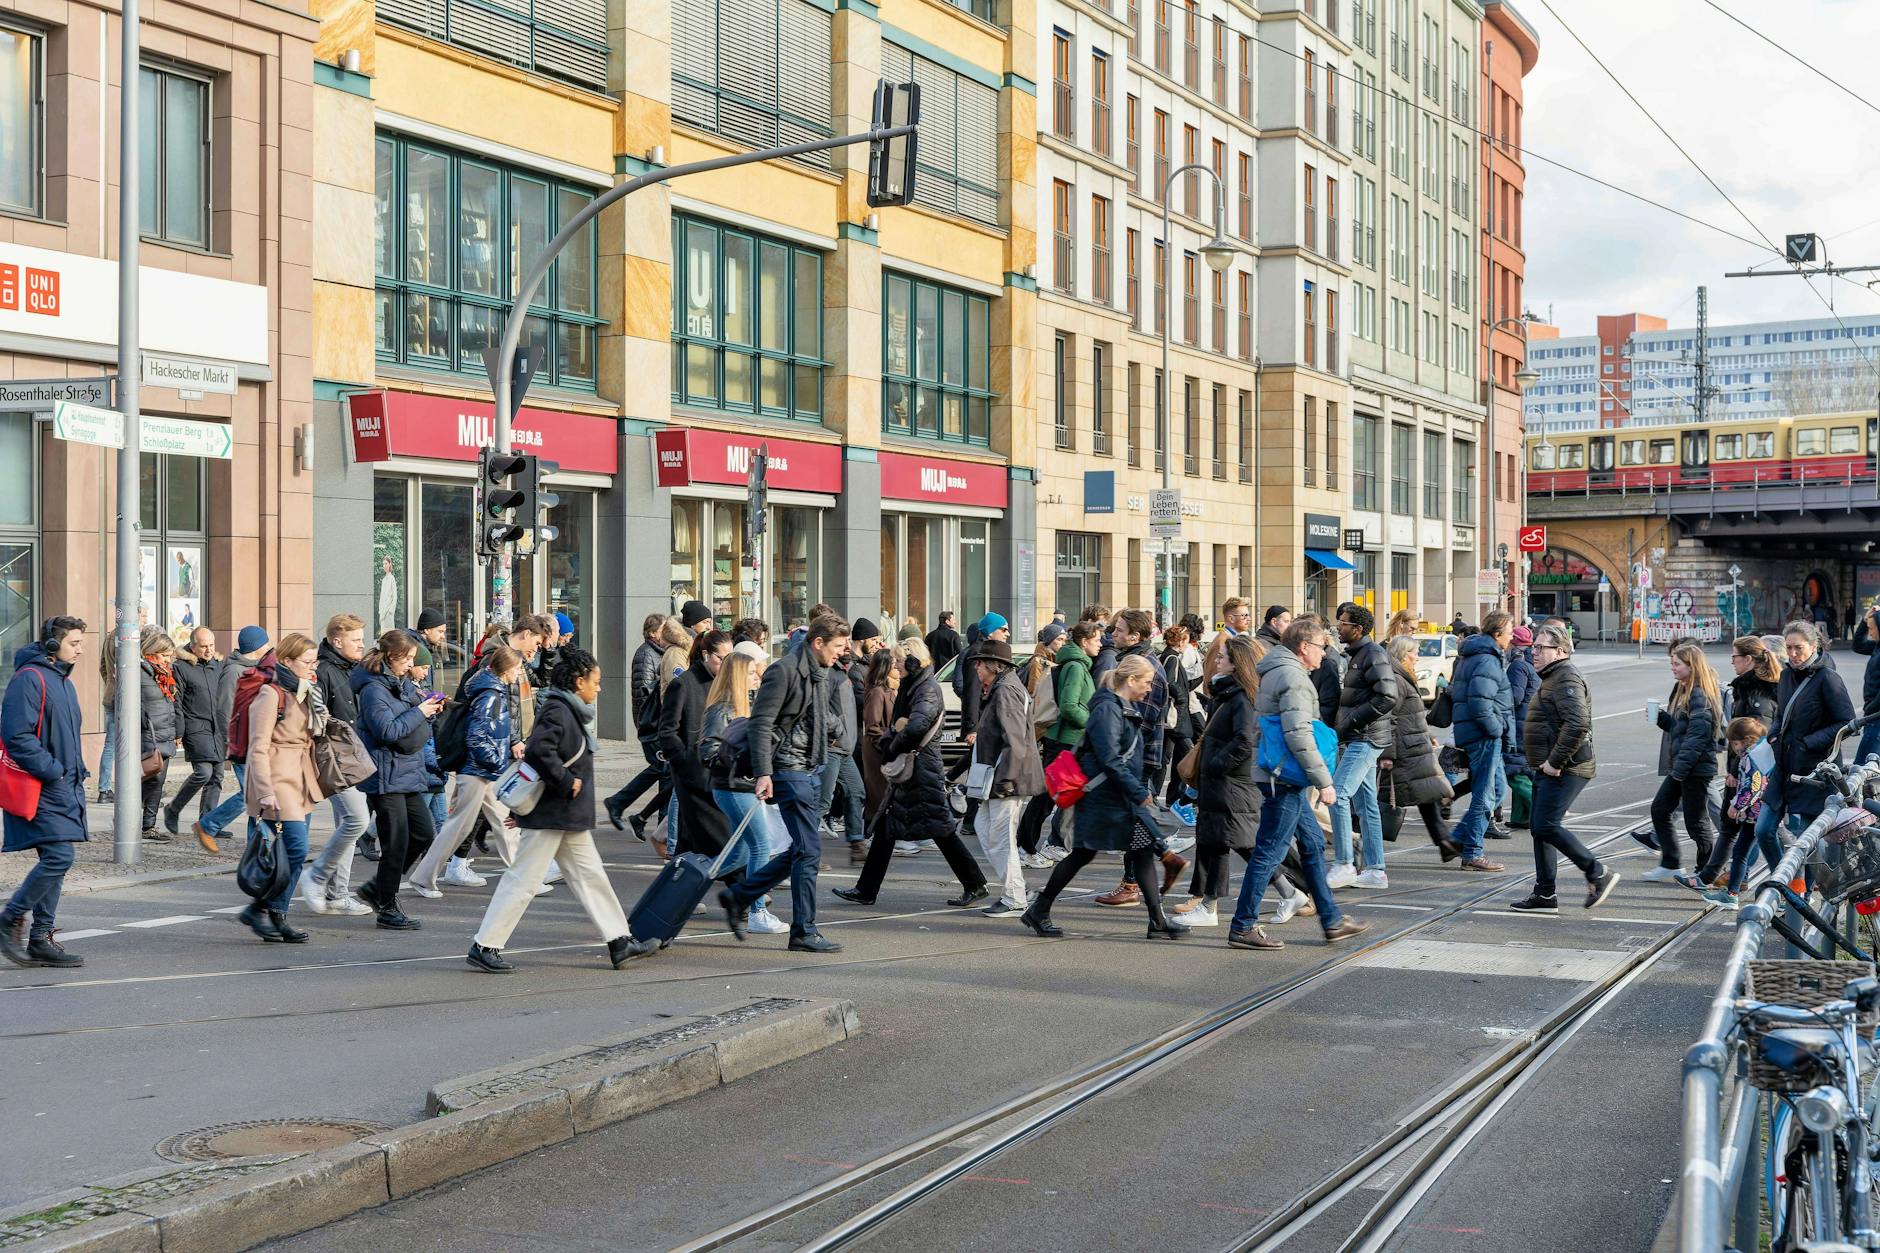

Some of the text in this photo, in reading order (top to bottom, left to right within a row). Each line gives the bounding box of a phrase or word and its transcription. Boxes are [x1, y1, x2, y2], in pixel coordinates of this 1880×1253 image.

[30, 273, 54, 292] UNI
[30, 292, 56, 310] QLO
[150, 361, 229, 384] Hackescher Markt
[0, 384, 102, 402] Rosenthaler Straße
[143, 421, 183, 435] Prenzlauer
[184, 425, 202, 439] Berg
[356, 416, 381, 431] MUJI
[458, 414, 496, 448] MUJ
[143, 436, 185, 450] Schloßplatz
[660, 450, 683, 463] MUJI
[921, 467, 946, 492] MUJI
[1152, 500, 1178, 509] Leben
[1156, 493, 1174, 501] Dein
[1150, 507, 1180, 516] retten!
[1309, 524, 1338, 537] MOLESKINE
